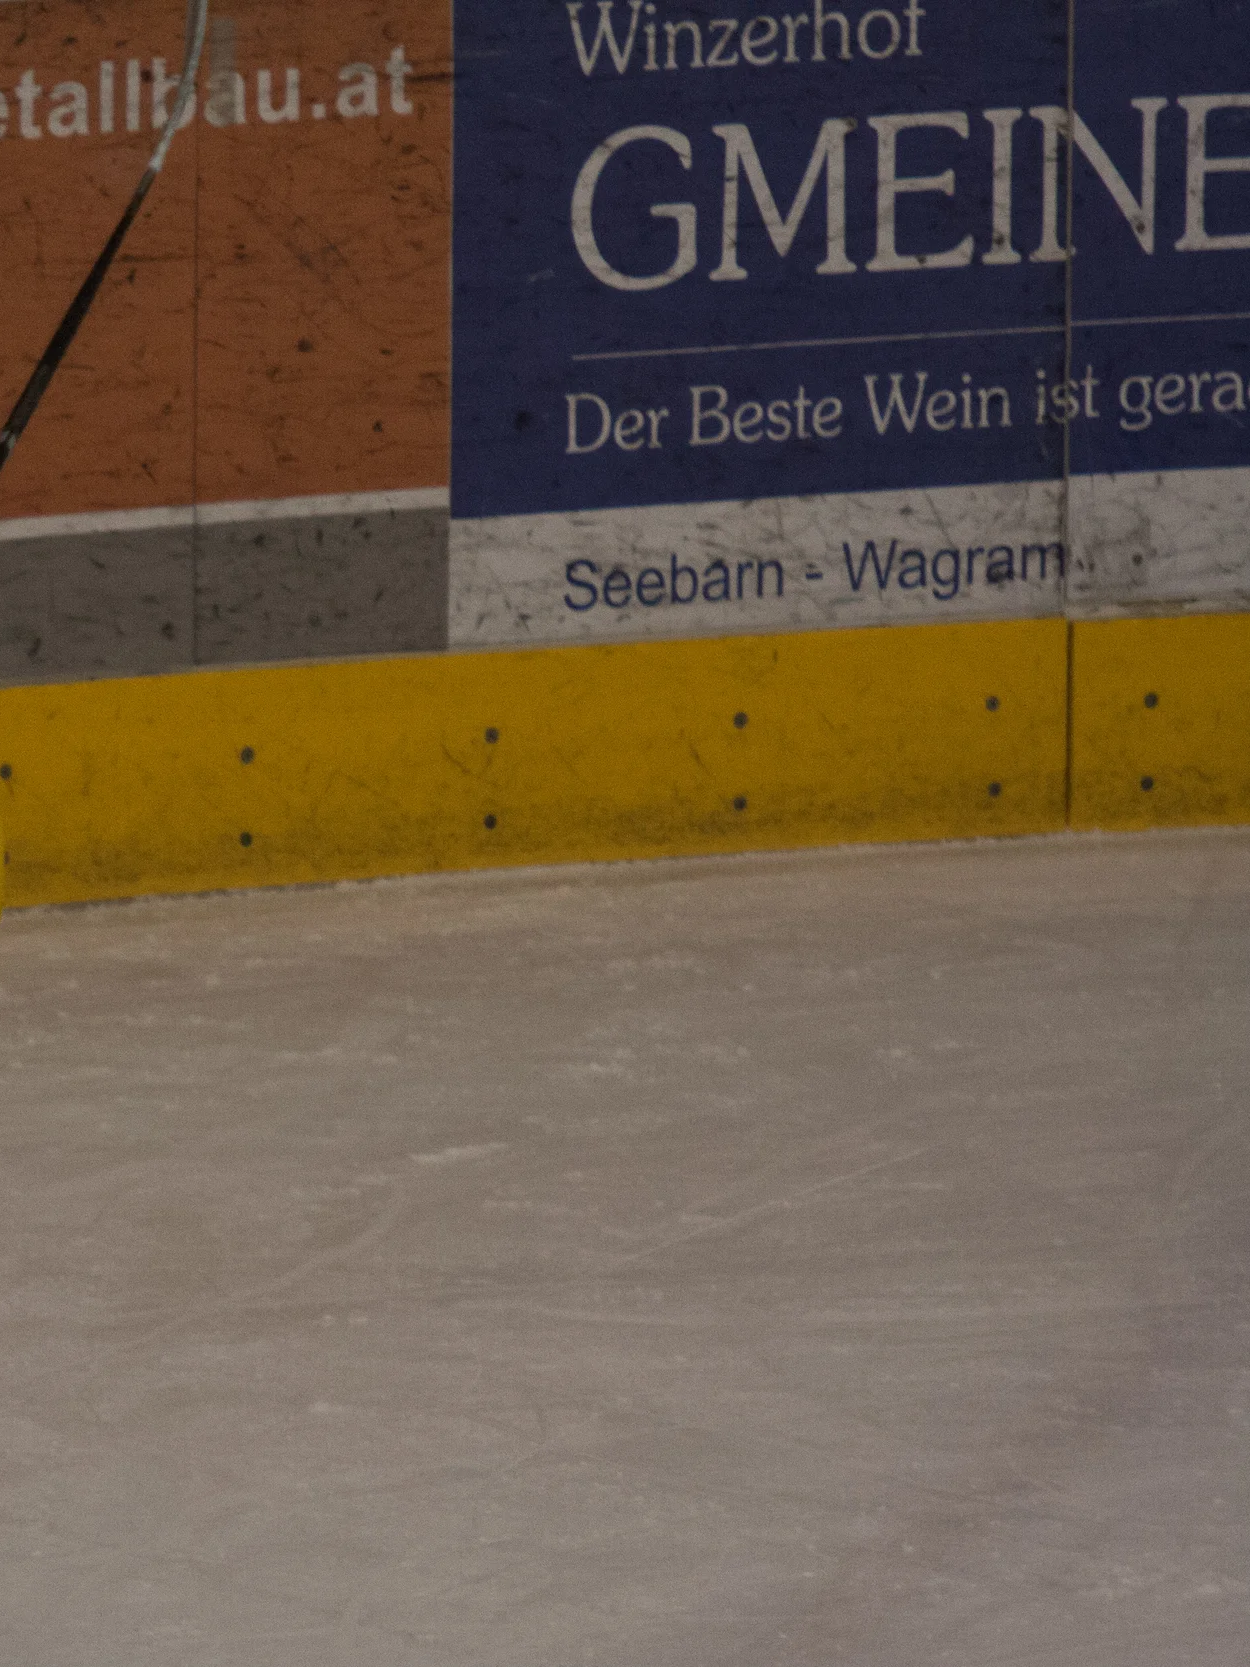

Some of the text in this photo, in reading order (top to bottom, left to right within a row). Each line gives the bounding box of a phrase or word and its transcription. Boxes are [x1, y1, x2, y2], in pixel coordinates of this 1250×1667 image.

[568, 0, 926, 76] Winzerhof
[564, 364, 1250, 455] Der Beste Wein ist gera
[563, 553, 786, 612] Seebarn
[842, 538, 1067, 601] Wagram
